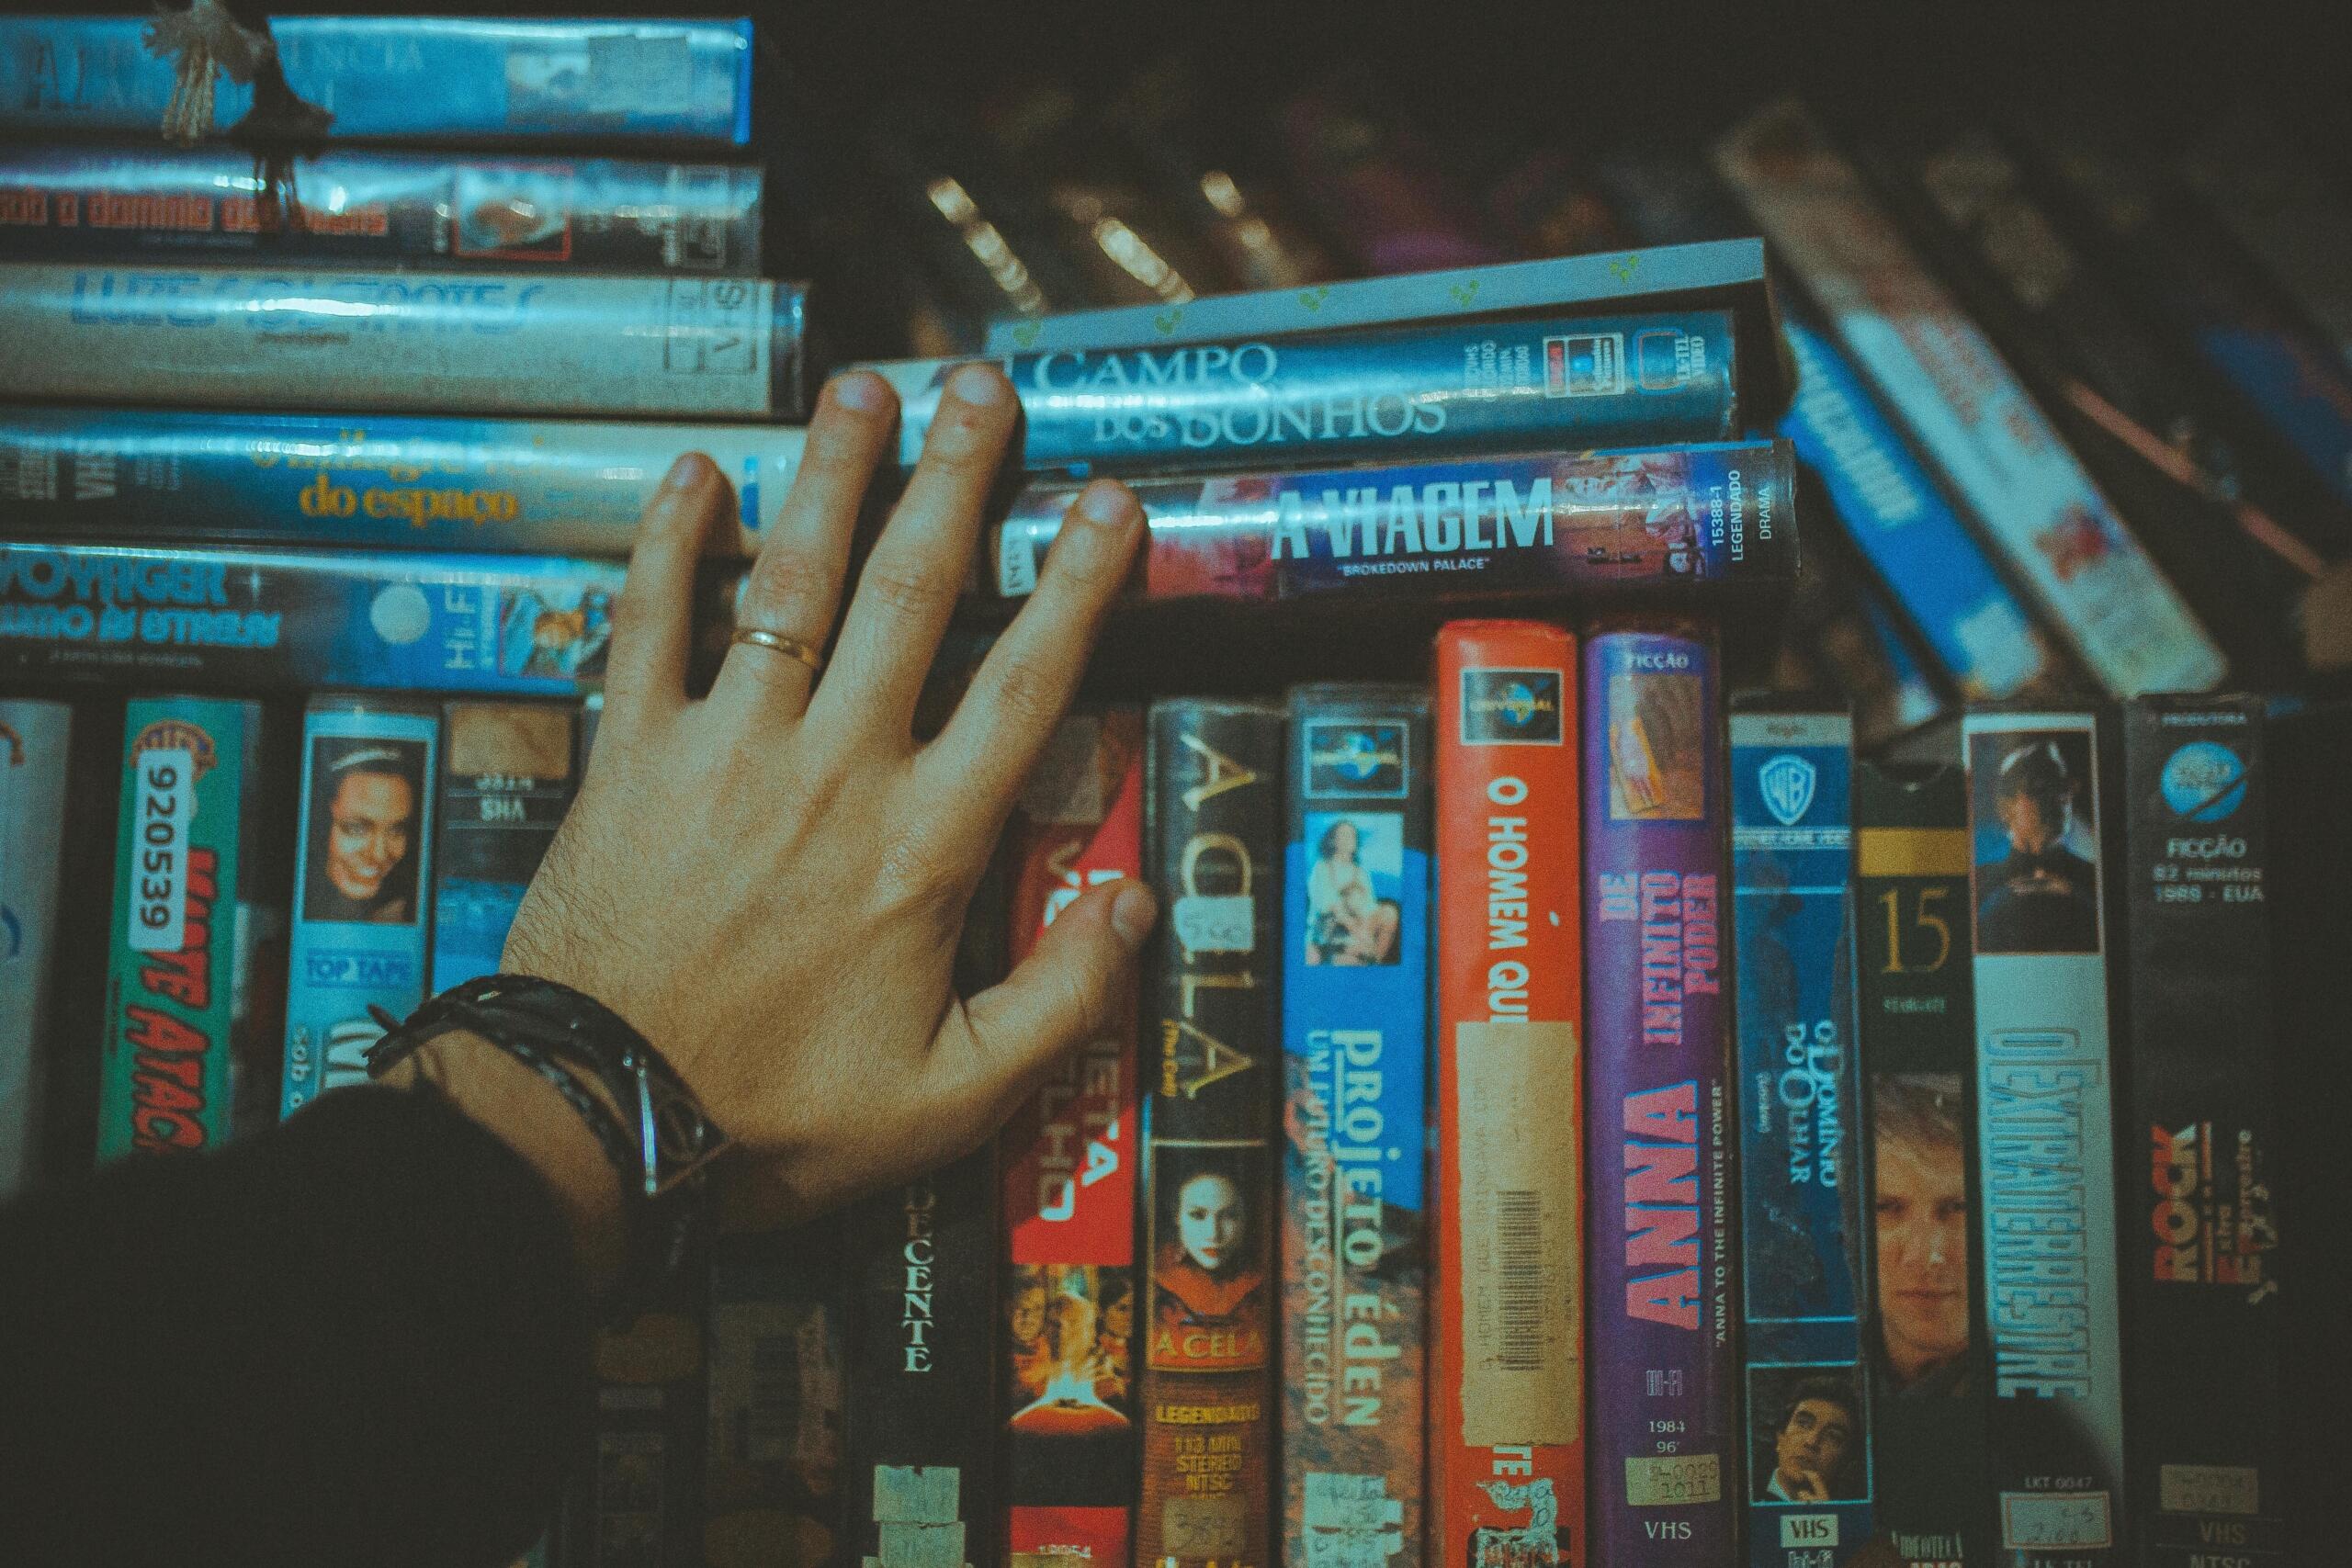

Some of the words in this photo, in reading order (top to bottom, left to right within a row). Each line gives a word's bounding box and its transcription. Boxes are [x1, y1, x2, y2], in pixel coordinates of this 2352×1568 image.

[1033, 343, 1279, 389] CAMPO
[1690, 335, 1706, 378] VIDEO
[1180, 388, 1448, 448] SONHOS
[299, 473, 358, 517] do
[363, 486, 519, 528] espaço
[1271, 490, 1310, 560] A
[1320, 477, 1554, 559] VIAGEM
[1709, 485, 1725, 548] 15388-1
[1727, 469, 1744, 562] LEGENDADO
[1758, 487, 1772, 541] DRAMA
[1624, 650, 1690, 671] FICÇÃO
[480, 796, 527, 821] VHS
[1487, 776, 1529, 806] O
[139, 764, 177, 931] 920539
[2165, 833, 2248, 861] FICÇÃO
[1486, 817, 1529, 951] HOMEM
[1598, 870, 1640, 921] DE
[2222, 884, 2266, 904] EUA
[1640, 869, 1683, 1045] INFINITO
[1683, 873, 1721, 996] PODER
[1878, 886, 1951, 976] 15
[1778, 1067, 1817, 1185] OLHAR
[1623, 1079, 1702, 1331] ANNA
[1713, 1151, 1725, 1224] INFINITE
[2150, 1122, 2199, 1283] ROCK
[1714, 1228, 1726, 1262] THE
[1714, 1265, 1726, 1289] TO
[1305, 1199, 1330, 1425] DESCONHECIDO
[1648, 1419, 1686, 1434] 1984
[1176, 1453, 1243, 1473] STEREO
[1645, 1521, 1692, 1540] VHS
[1790, 1518, 1830, 1539] VHS
[2199, 1519, 2246, 1545] VHS
